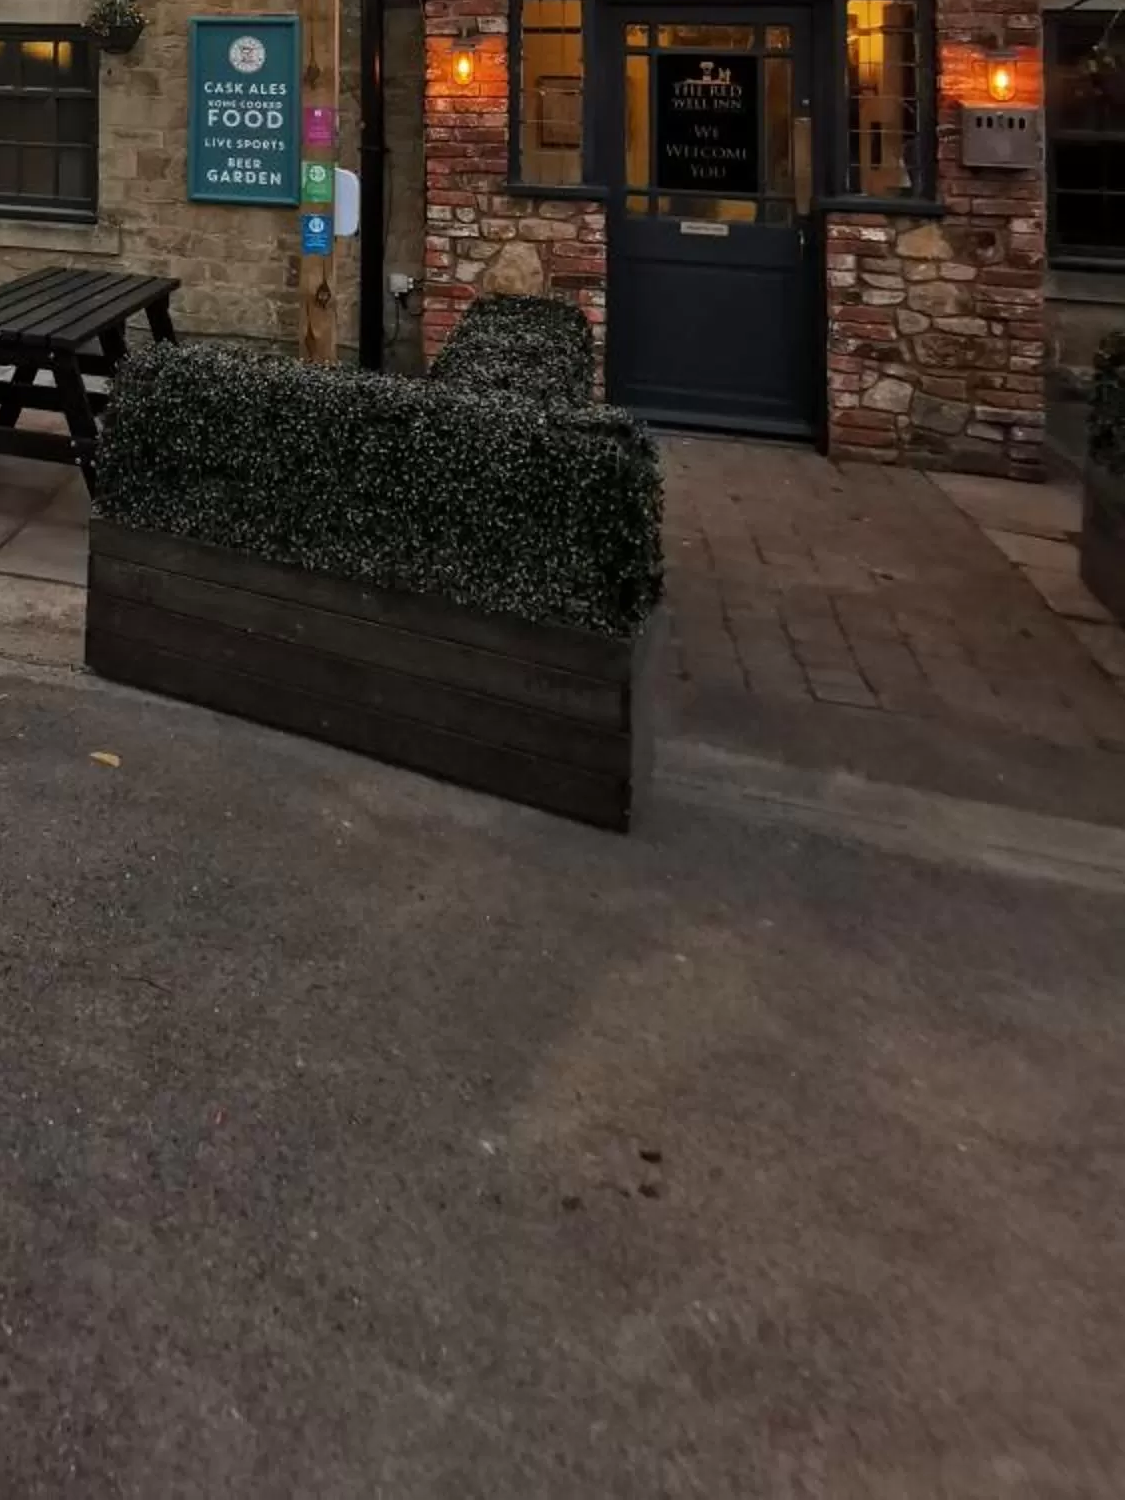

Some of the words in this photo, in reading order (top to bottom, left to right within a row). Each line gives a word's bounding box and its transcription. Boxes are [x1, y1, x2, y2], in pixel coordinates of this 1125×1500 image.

[204, 82, 244, 95] CASK
[248, 83, 288, 96] ALES
[207, 109, 284, 129] FOOD
[204, 138, 233, 149] LIVE
[236, 139, 286, 151] SPORTS
[227, 157, 263, 169] BEER
[206, 169, 282, 186] GARDEN
